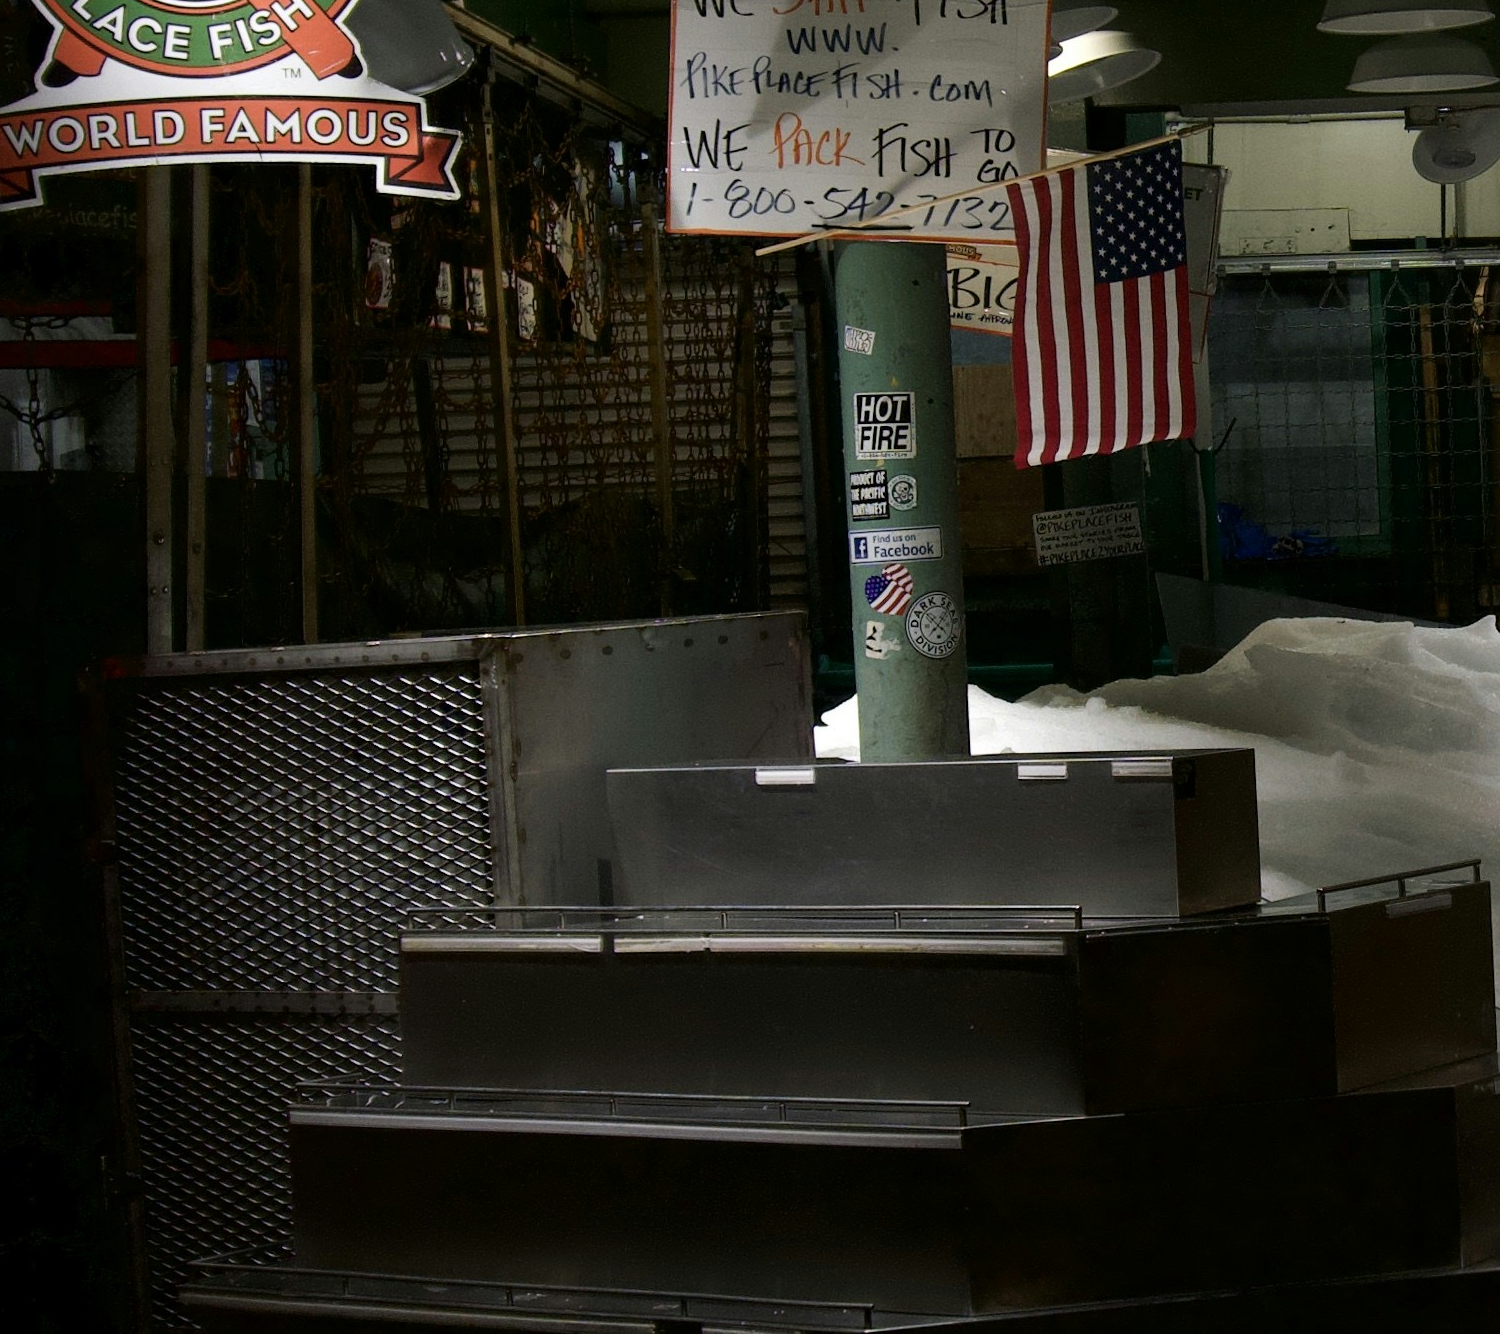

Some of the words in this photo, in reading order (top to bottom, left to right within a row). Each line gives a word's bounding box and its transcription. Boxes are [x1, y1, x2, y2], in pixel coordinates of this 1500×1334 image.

[1, 109, 187, 158] WORLD
[200, 107, 412, 149] FAMOUS
[683, 119, 752, 171] WE
[773, 112, 866, 167] PACK
[872, 123, 957, 178] FISH
[971, 129, 1016, 153] TO
[860, 395, 909, 423] HOT
[860, 425, 909, 451] FIRE
[872, 534, 890, 544] Find
[892, 535, 902, 543] us
[904, 534, 917, 542] on
[874, 542, 935, 558] Facebook
[910, 596, 936, 628] DARK
[915, 634, 957, 655] DIVISION
